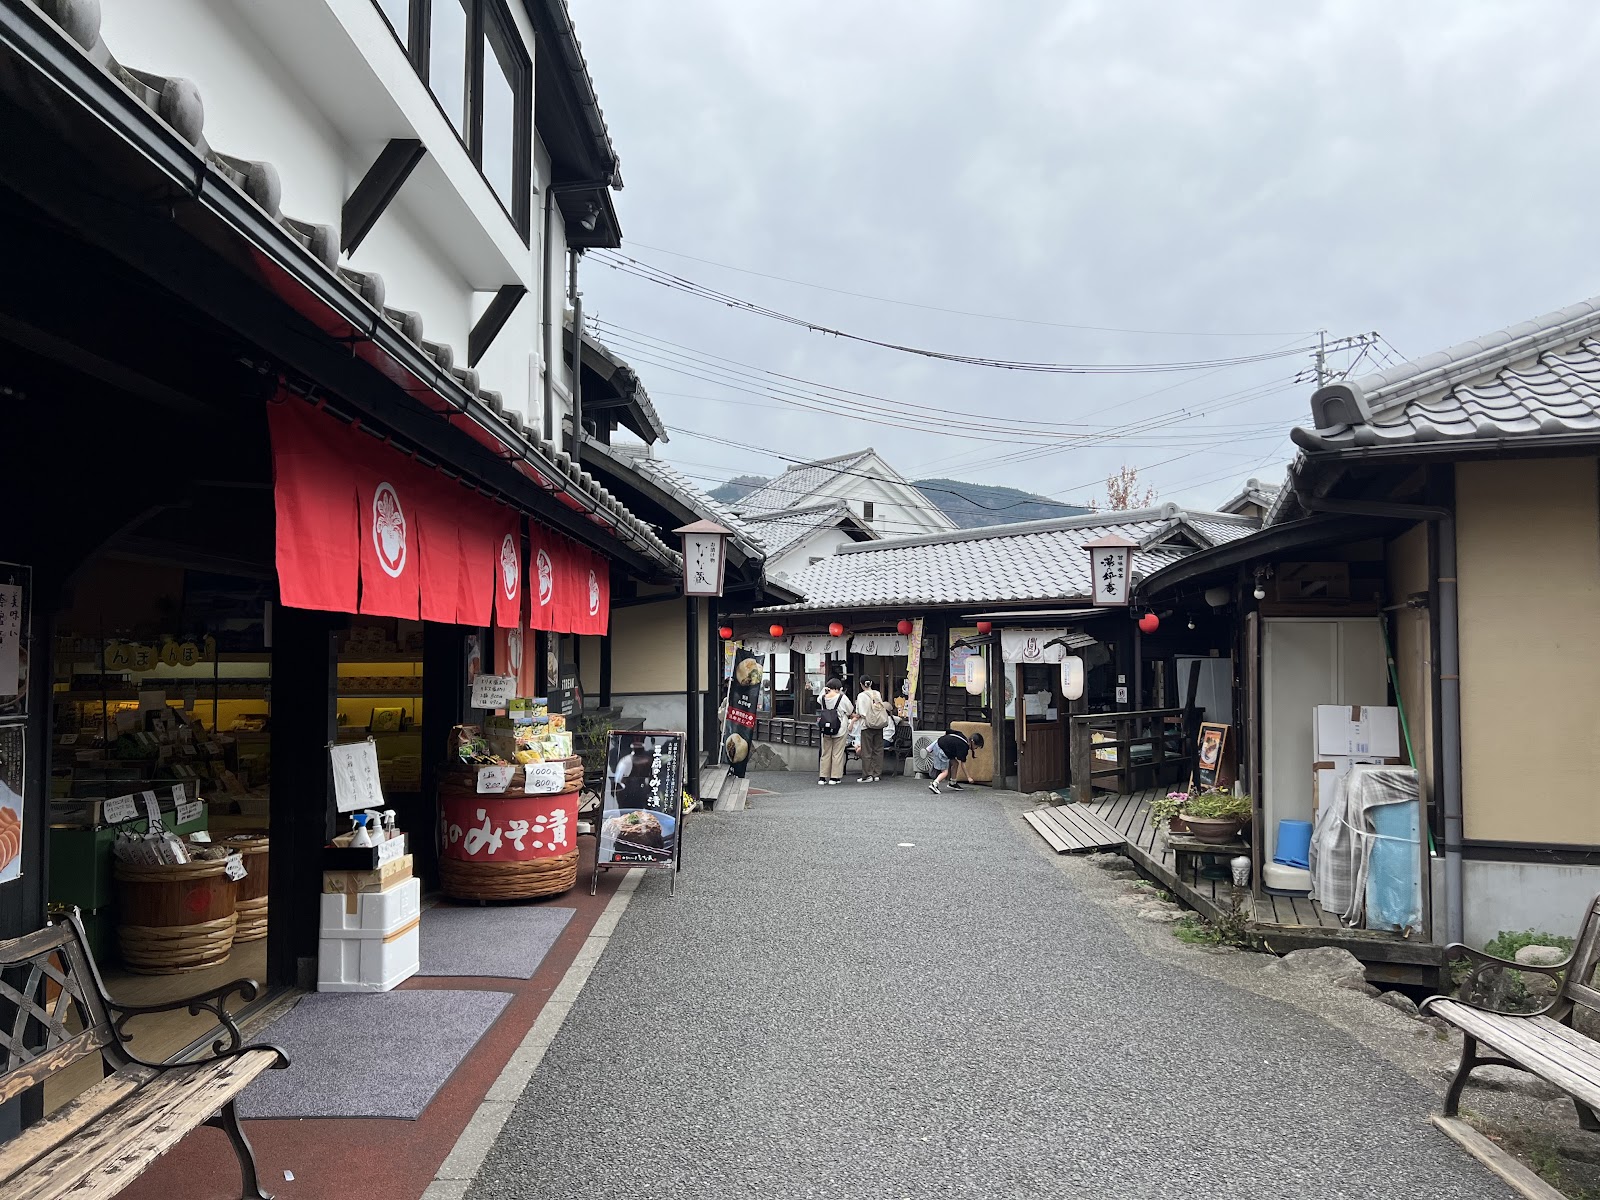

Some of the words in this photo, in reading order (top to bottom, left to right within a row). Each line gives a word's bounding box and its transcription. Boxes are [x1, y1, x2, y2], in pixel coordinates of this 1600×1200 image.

[647, 744, 662, 808] 豆腐のみそ漬
